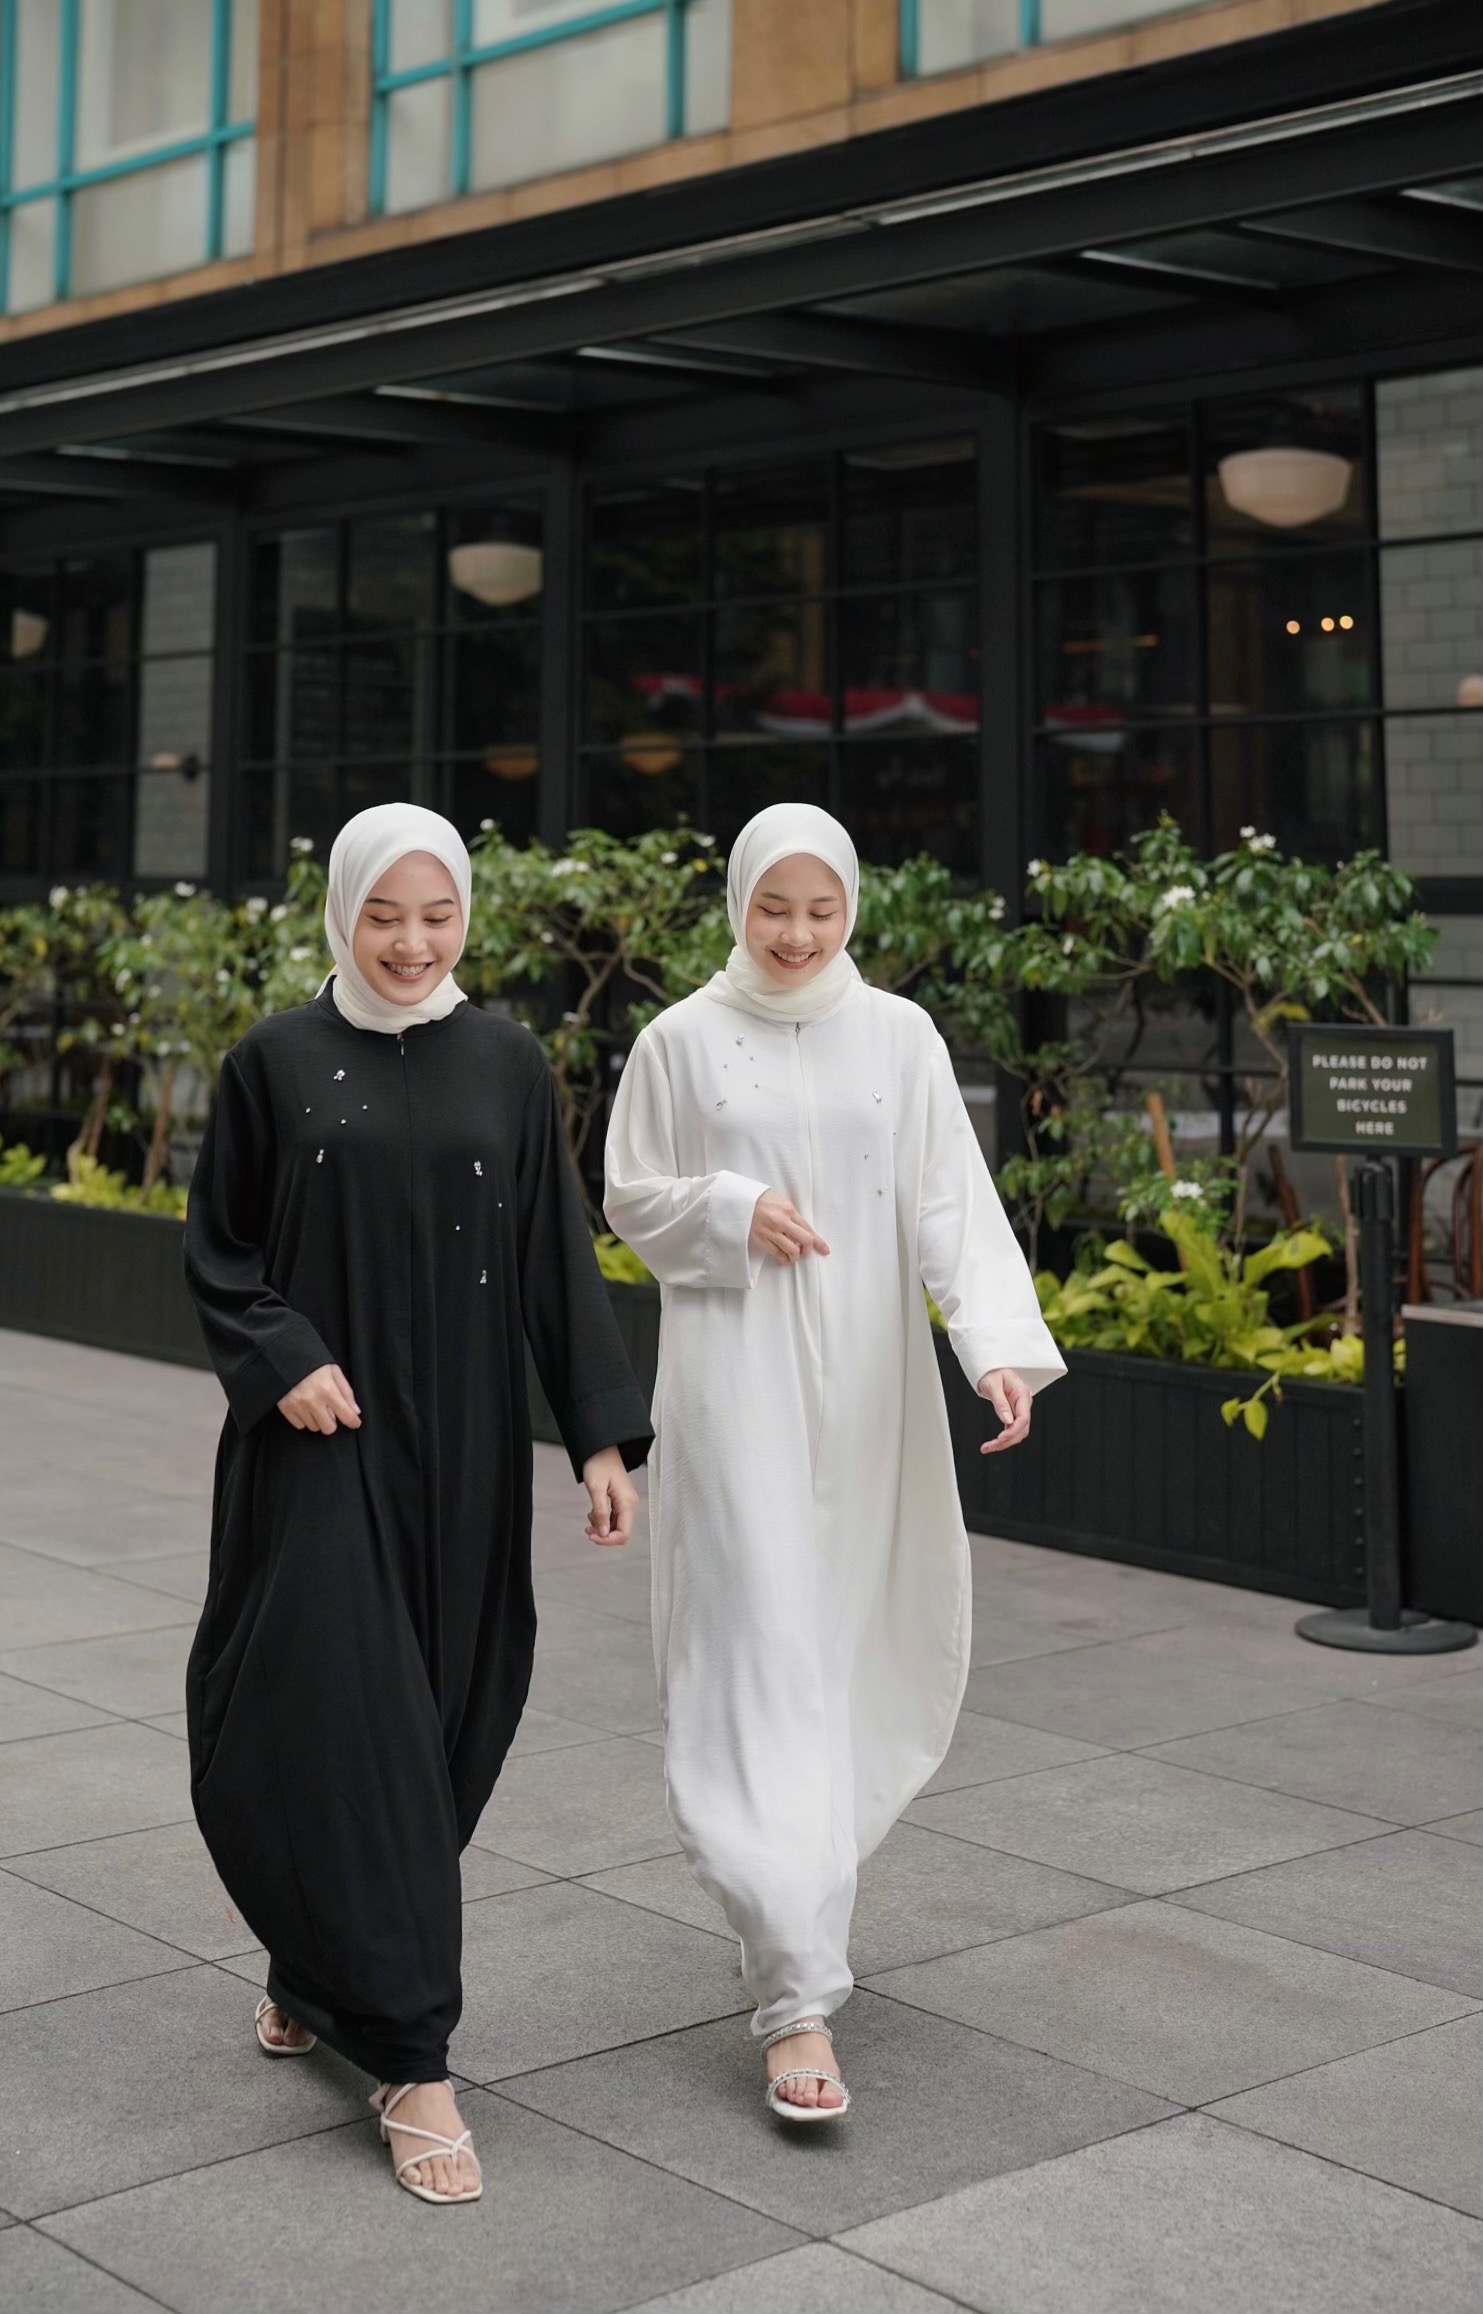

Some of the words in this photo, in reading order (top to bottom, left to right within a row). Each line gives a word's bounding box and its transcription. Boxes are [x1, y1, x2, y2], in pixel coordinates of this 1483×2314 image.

[1312, 1054, 1366, 1069] PLEASE
[1370, 1056, 1393, 1070] DO
[1396, 1057, 1427, 1070] NOT
[1329, 1077, 1367, 1090] PARK
[1371, 1078, 1412, 1092] YOUR
[1336, 1098, 1407, 1113] BICYCLES
[1355, 1121, 1394, 1135] HERE
